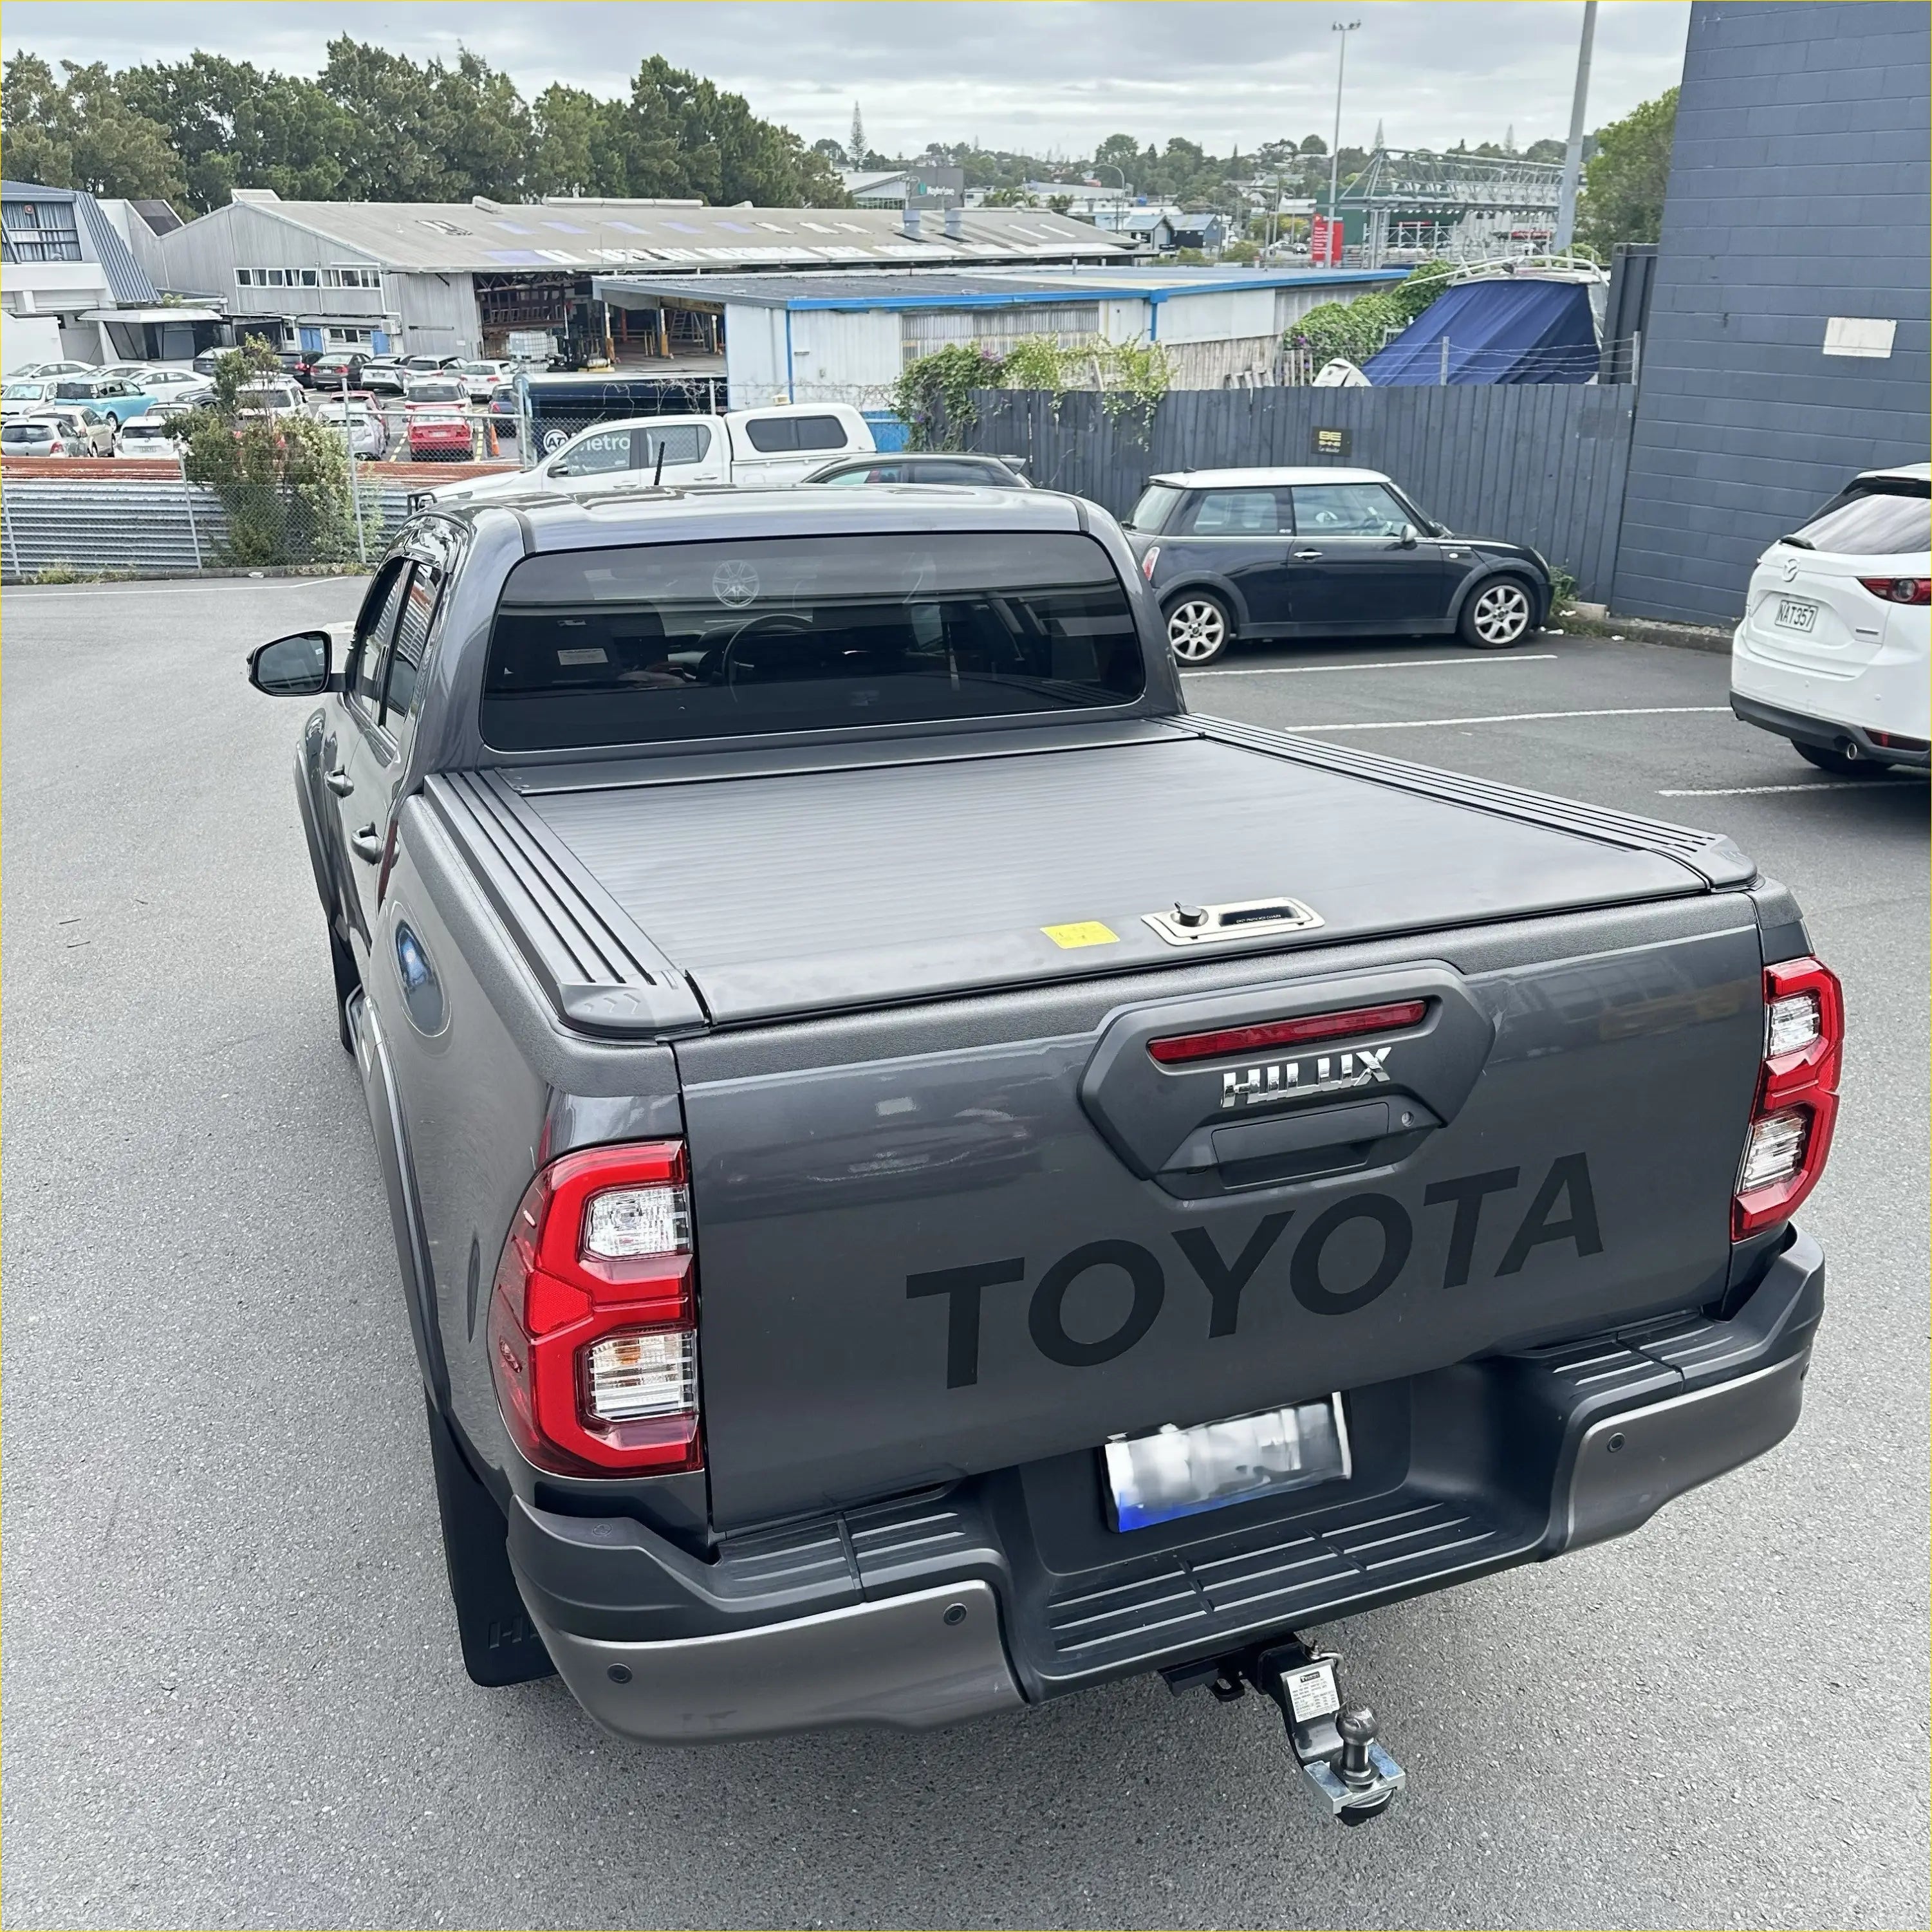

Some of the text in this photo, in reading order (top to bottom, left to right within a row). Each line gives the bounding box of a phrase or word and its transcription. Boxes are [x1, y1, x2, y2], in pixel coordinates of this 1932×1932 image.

[1778, 602, 1815, 627] NAT357
[1221, 1047, 1391, 1108] HILUX
[906, 1152, 1604, 1389] TOYOTA
